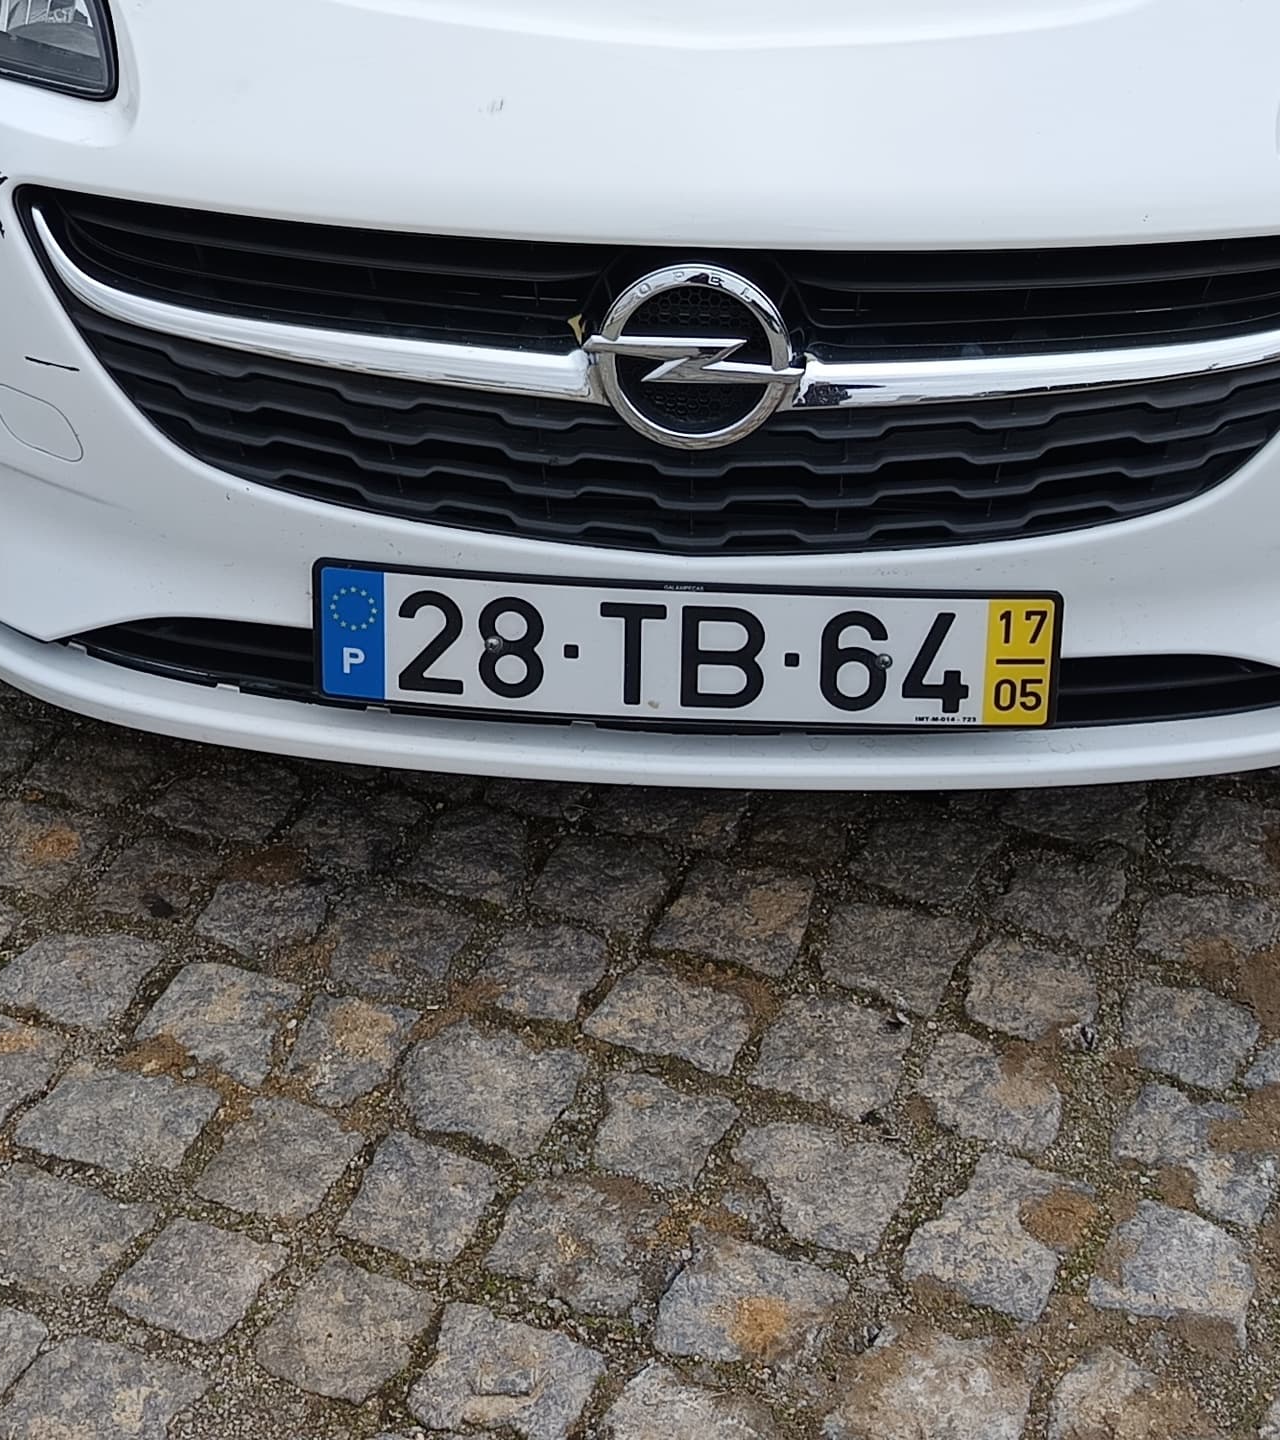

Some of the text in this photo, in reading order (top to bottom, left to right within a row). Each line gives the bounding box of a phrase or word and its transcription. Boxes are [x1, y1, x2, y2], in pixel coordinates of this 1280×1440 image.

[639, 271, 753, 302] OPEL
[1000, 610, 1048, 644] 17
[342, 647, 365, 674] P
[994, 678, 1043, 711] 05
